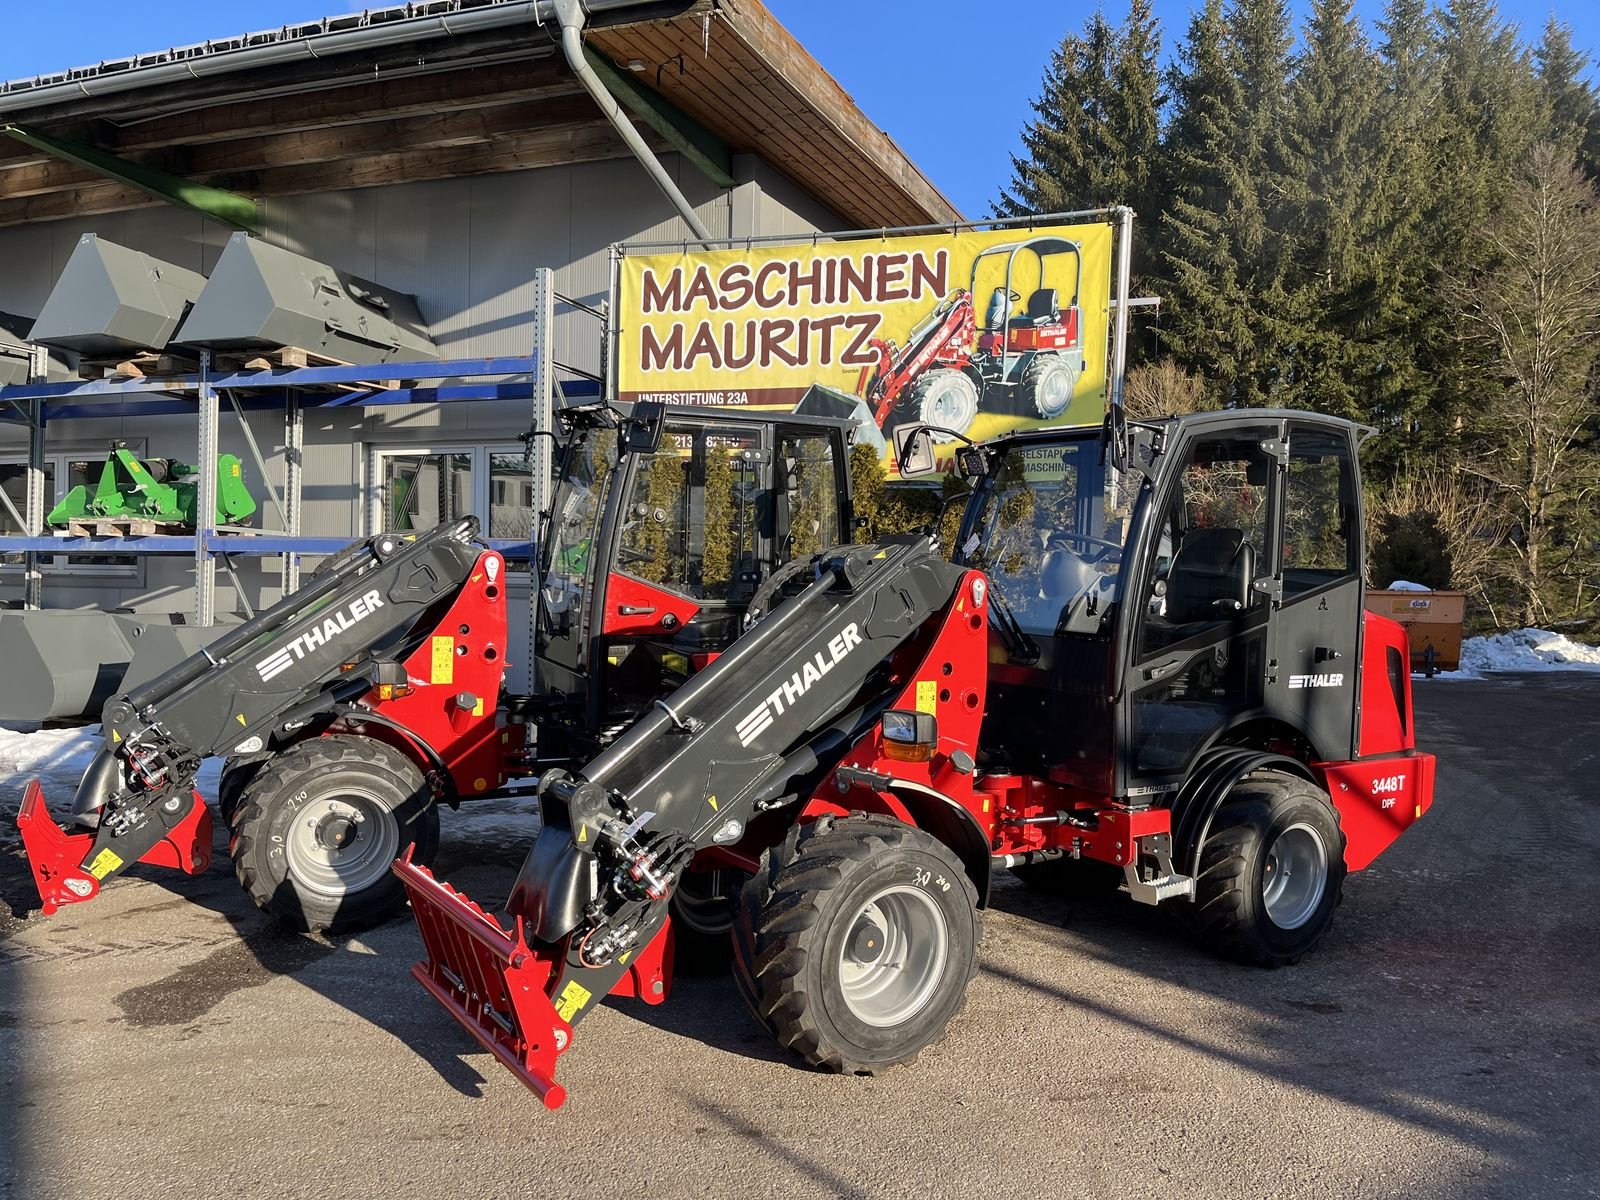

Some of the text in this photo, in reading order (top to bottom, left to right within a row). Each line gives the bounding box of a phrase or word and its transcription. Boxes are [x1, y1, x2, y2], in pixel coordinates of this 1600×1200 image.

[642, 250, 947, 313] MASCHINEN
[641, 314, 881, 370] MAURITZ
[638, 391, 748, 405] UNTERSTIFTUNG 23A
[286, 589, 385, 660] THALER
[766, 622, 863, 716] THALER
[1303, 673, 1343, 688] THALER
[1371, 774, 1406, 795] 3448T
[1381, 797, 1396, 809] DPF
